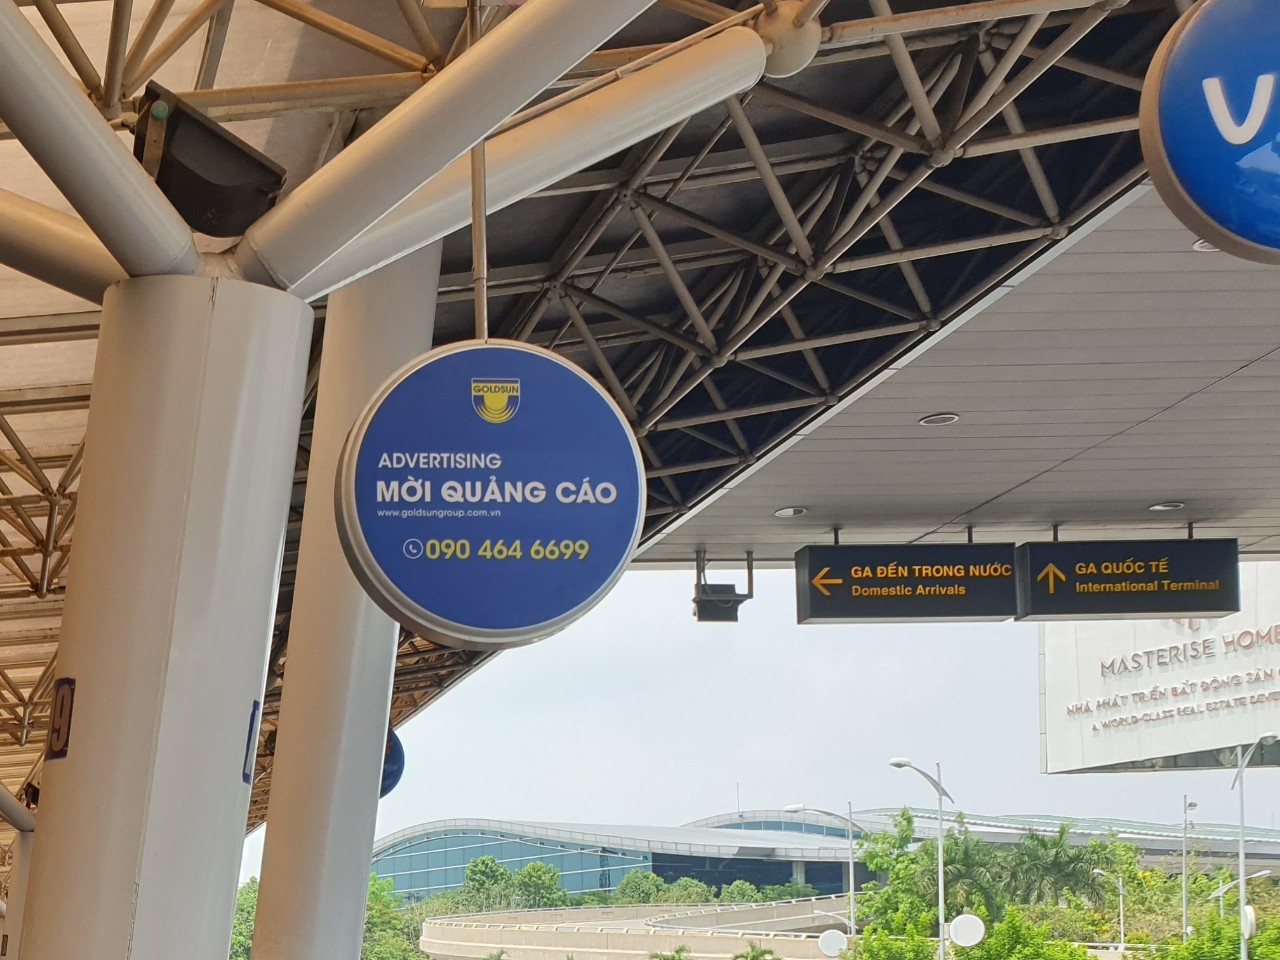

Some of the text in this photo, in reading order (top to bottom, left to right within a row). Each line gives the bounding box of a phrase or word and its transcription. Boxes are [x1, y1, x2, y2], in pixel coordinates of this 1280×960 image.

[473, 384, 519, 394] GOLDSUN
[378, 453, 502, 469] ADVERTISING
[376, 475, 617, 504] MỜI QUẢNG CÁO
[377, 508, 501, 518] www.goldsungroup.com.vn
[426, 539, 590, 560] 090 464 6699
[851, 561, 1012, 578] GA ĐẾN TRONG NƯỚC
[1075, 557, 1169, 575] GA QUỐC TẾ
[851, 584, 966, 596] Domestic Arrivals
[1076, 579, 1220, 593] International Terminal
[1100, 637, 1216, 677] MASTERISE
